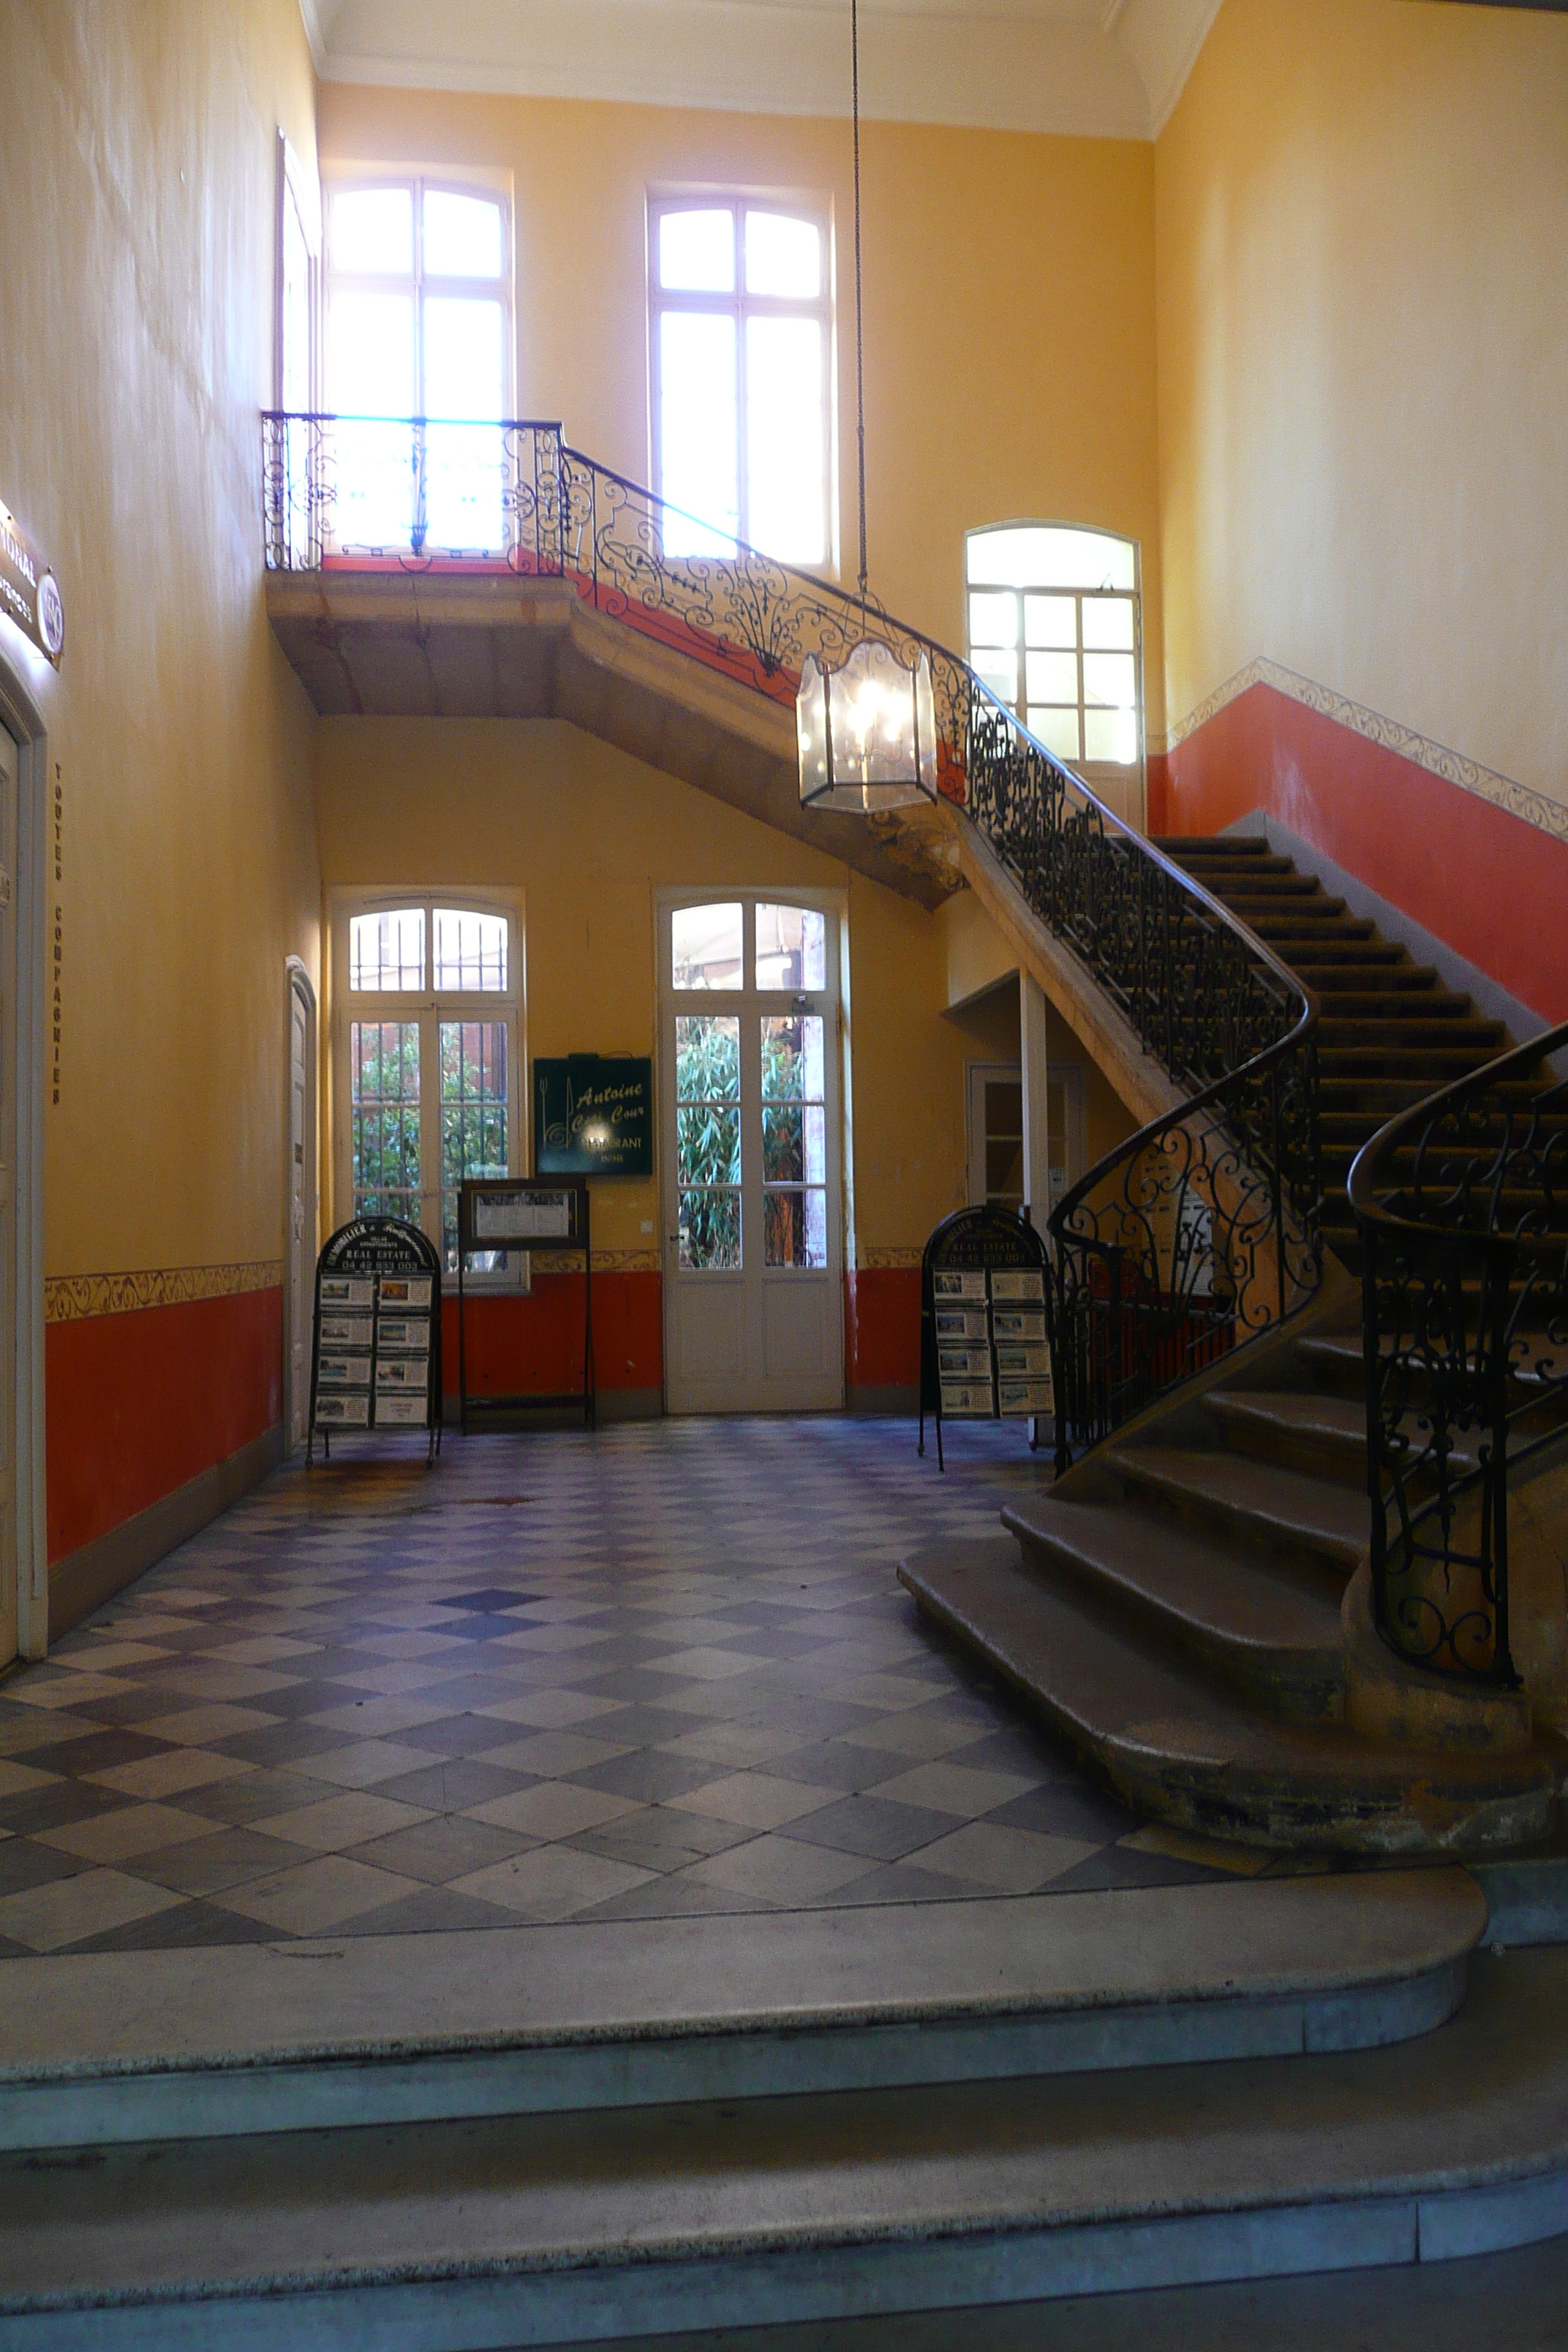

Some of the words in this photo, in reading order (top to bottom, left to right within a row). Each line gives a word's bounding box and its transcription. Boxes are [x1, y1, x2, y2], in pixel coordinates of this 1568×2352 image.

[53, 904, 62, 1105] COMPAGNIES
[576, 1082, 643, 1109] Antoine
[611, 1104, 645, 1125] Cour
[326, 1222, 367, 1267] IMMOBILIER
[346, 1250, 372, 1259] REAL
[377, 1250, 410, 1259] ESTATE
[952, 1242, 977, 1251] REAL
[983, 1242, 1017, 1251] ESTATE
[342, 1261, 355, 1270] 04
[359, 1261, 372, 1270] 42
[398, 1262, 418, 1271] 003
